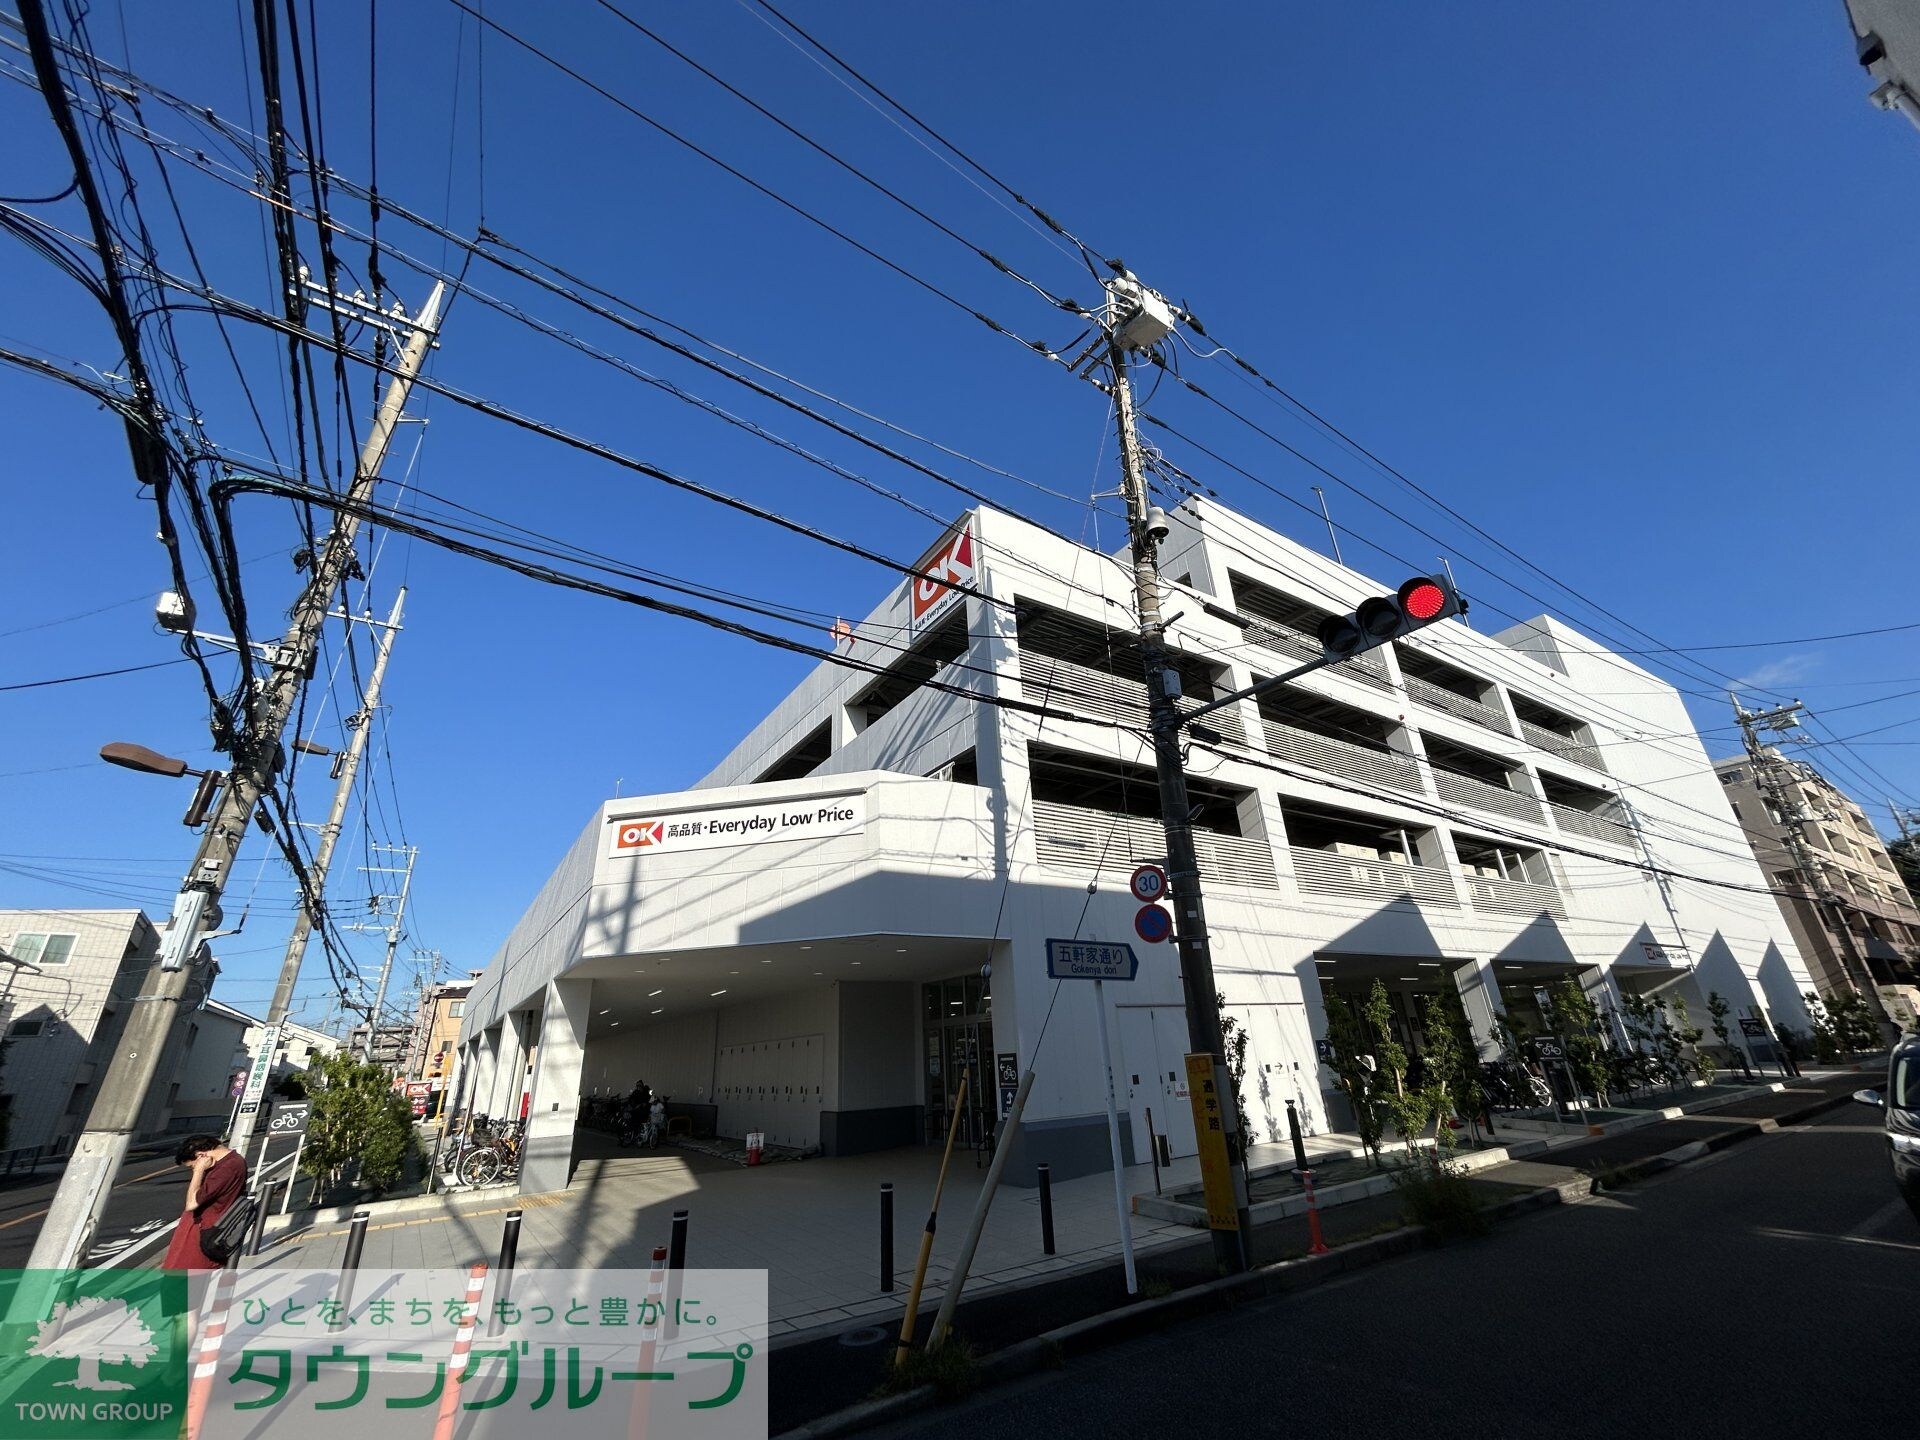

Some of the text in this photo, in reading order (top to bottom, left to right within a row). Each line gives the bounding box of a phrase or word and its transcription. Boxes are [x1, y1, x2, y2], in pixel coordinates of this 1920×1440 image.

[919, 518, 976, 601] OK
[782, 808, 813, 827] Low
[818, 807, 854, 823] Price
[621, 821, 663, 848] OK
[1138, 874, 1159, 892] 30
[1058, 945, 1123, 965] 五軒家通り
[1071, 963, 1101, 975] Gokenya
[1203, 1079, 1220, 1130] 通学路
